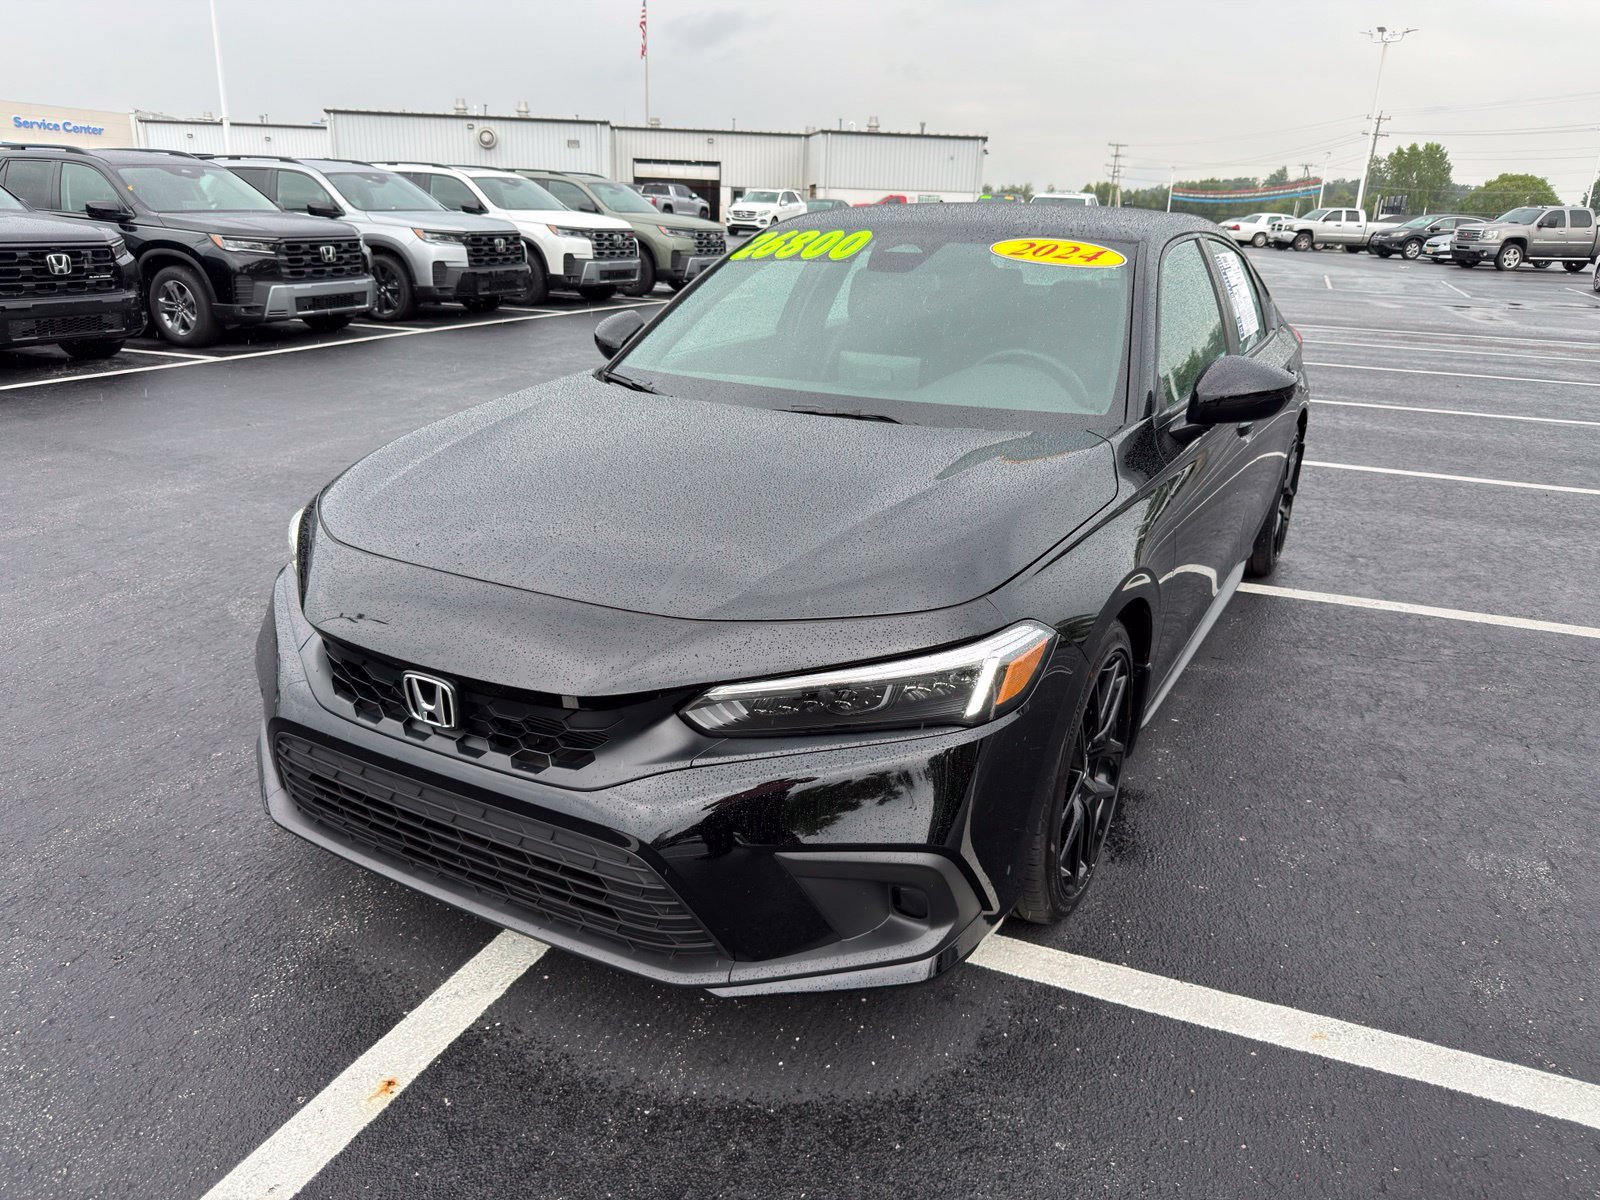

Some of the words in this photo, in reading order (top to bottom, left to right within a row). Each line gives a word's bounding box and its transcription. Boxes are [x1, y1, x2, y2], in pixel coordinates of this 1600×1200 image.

[13, 116, 60, 131] Service
[62, 121, 104, 135] Center
[730, 230, 872, 260] 26800
[1008, 242, 1107, 262] 2024
